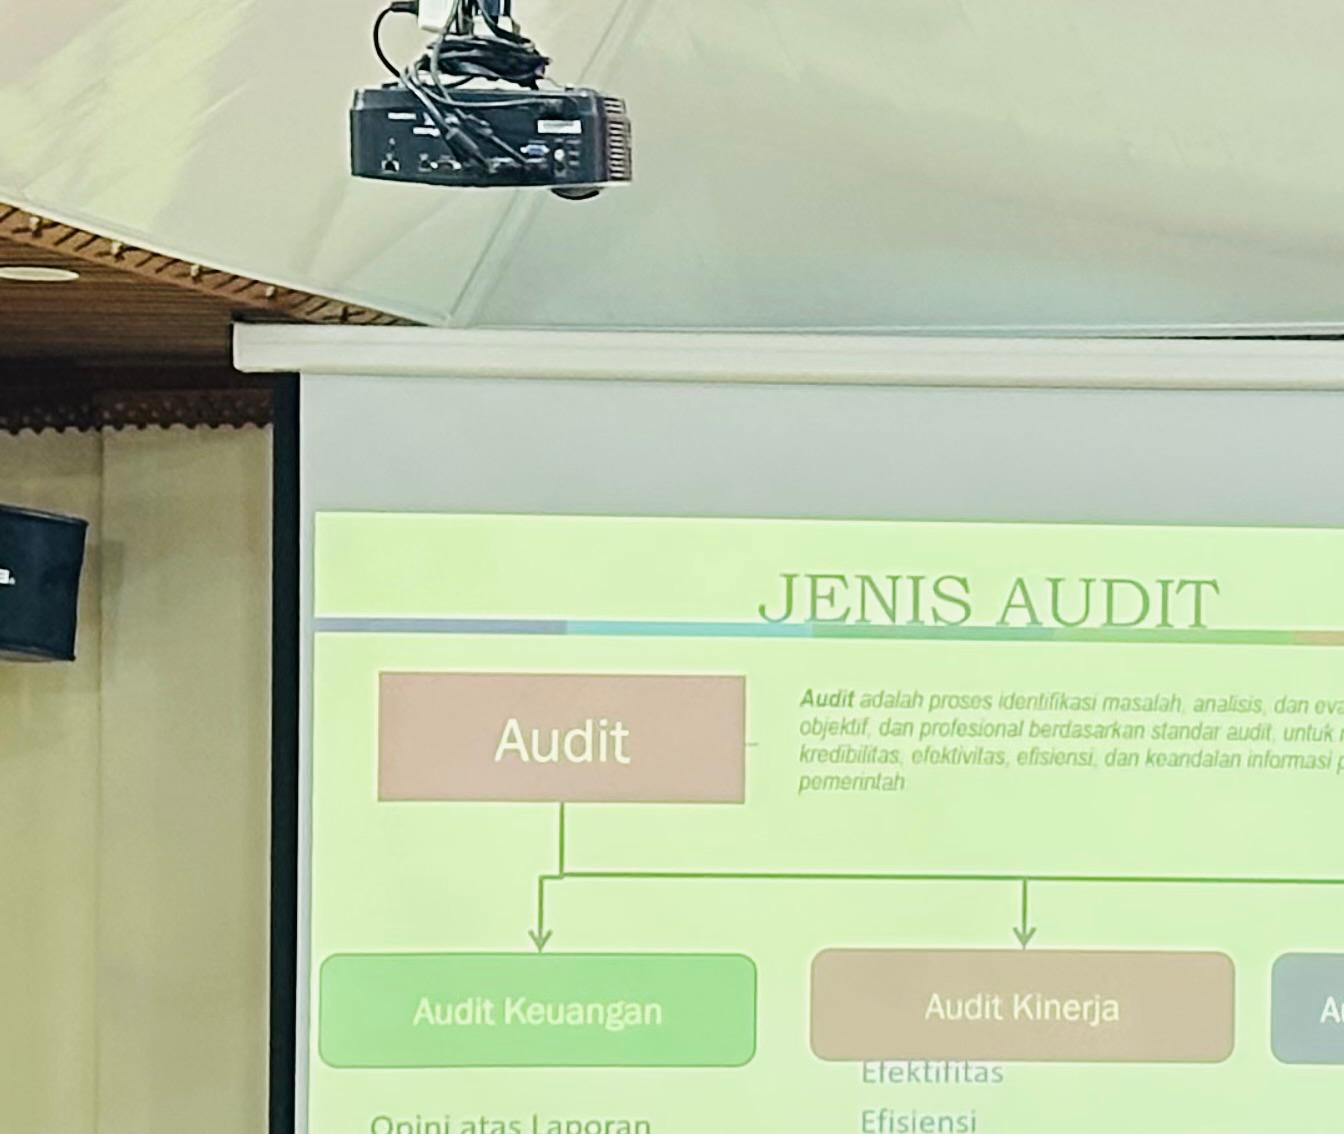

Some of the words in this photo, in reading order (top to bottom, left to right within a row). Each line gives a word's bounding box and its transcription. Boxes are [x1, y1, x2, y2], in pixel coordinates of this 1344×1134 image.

[758, 574, 973, 627] JENIS
[998, 576, 1221, 630] AUDIT
[800, 688, 855, 709] Audit
[859, 689, 924, 710] adalah
[928, 692, 993, 713] proses
[998, 691, 1098, 712] identifikasi
[1102, 693, 1186, 715] masalah,
[1193, 694, 1267, 716] analisis,
[1274, 695, 1309, 715] dan
[494, 717, 631, 765] Audit
[800, 716, 871, 741] objektif,
[879, 718, 913, 738] dan
[918, 718, 1024, 743] profesional
[1029, 720, 1145, 740] berdasarkan
[1151, 722, 1219, 742] standar
[1226, 723, 1276, 743] audit,
[1283, 724, 1333, 743] untuk
[800, 744, 904, 765] kredibilitas,
[911, 745, 1010, 768] efektivitas,
[1016, 747, 1097, 768] efisiensi,
[1104, 748, 1139, 768] dan
[1145, 748, 1241, 769] keandalan
[1247, 749, 1331, 770] informasi
[799, 772, 905, 796] pemerintah
[413, 998, 496, 1026] Audit
[503, 998, 663, 1032] Keuangan
[925, 993, 1003, 1021] Audit
[1013, 994, 1120, 1028] Kinerja
[861, 1109, 977, 1134] Efisiensi
